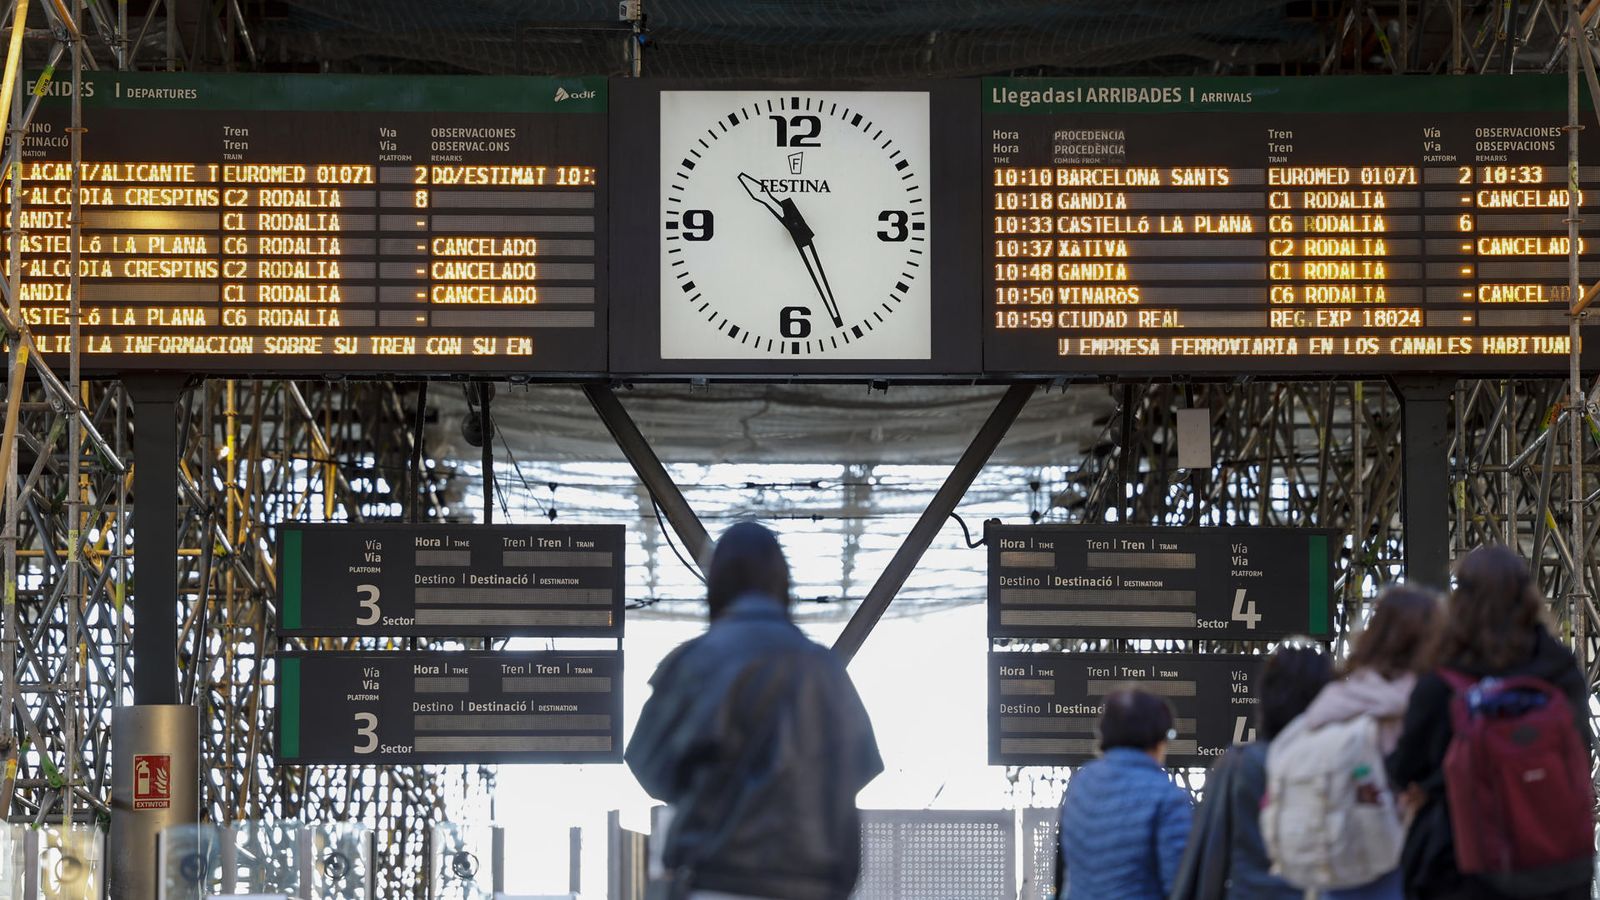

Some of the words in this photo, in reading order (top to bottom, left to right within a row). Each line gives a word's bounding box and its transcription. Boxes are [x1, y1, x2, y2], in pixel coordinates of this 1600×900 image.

[128, 89, 196, 99] DEPARTURES
[993, 88, 1074, 107] Llegadas
[1086, 88, 1181, 102] ARRIBADES
[1201, 93, 1251, 102] ARRIVALS
[224, 127, 248, 136] Tren
[432, 128, 515, 138] OBSERVACIONES
[769, 116, 821, 147] 12
[993, 130, 1018, 139] Hora
[1055, 131, 1125, 140] PROCEDENCIA
[1268, 129, 1292, 138] Tren
[1424, 128, 1440, 137] Vía
[1476, 128, 1561, 137] OBSERVACIONES
[224, 140, 248, 149] Tren
[380, 141, 396, 150] Via
[994, 144, 1018, 153] Hora
[1268, 143, 1292, 152] Tren
[1476, 141, 1555, 151] OBSERVACIONS
[224, 166, 305, 182] EUROMED
[317, 166, 373, 183] 01071
[415, 167, 427, 184] 2
[995, 169, 1051, 186] 10:10
[1057, 169, 1160, 185] BARCELONA
[1172, 169, 1229, 185] SANTS
[1269, 168, 1349, 185] EUROMED
[1361, 168, 1416, 184] 01071
[1460, 167, 1471, 183] 2
[1483, 167, 1542, 183] 10:33
[760, 180, 831, 193] FESTINA
[125, 189, 219, 206] CRESPINS
[225, 190, 248, 206] C2
[260, 190, 340, 207] RODALIA
[416, 191, 427, 207] 8
[996, 193, 1052, 209] 10:18
[1058, 193, 1126, 209] GANDIA
[1270, 192, 1291, 208] C1
[1305, 192, 1385, 208] RODALIA
[224, 213, 246, 230] C1
[259, 214, 340, 231] RODALIA
[683, 210, 713, 241] 9
[877, 211, 908, 242] 3
[995, 217, 1052, 233] 10:33
[1161, 216, 1183, 232] LA
[1195, 216, 1252, 232] PLANA
[1269, 216, 1292, 232] C6
[1305, 216, 1385, 232] RODALIA
[1460, 215, 1471, 231] 6
[114, 237, 136, 253] LA
[149, 237, 206, 253] PLANA
[225, 237, 247, 254] C6
[260, 238, 340, 254] RODALIA
[433, 239, 536, 256] CANCELADO
[996, 241, 1052, 257] 10:37
[1270, 240, 1293, 256] C2
[1305, 239, 1386, 256] RODALIA
[124, 261, 218, 278] CRESPINS
[224, 261, 247, 278] C2
[259, 262, 340, 278] RODALIA
[432, 263, 536, 279] CANCELADO
[996, 264, 1052, 280] 10:48
[1058, 264, 1127, 280] GANDIA
[1270, 263, 1291, 279] C1
[1304, 263, 1385, 279] RODALIA
[224, 285, 245, 302] C1
[259, 285, 340, 302] RODALIA
[433, 286, 536, 303] CANCELADO
[996, 288, 1053, 304] 10:50
[1271, 287, 1294, 303] C6
[1305, 287, 1385, 303] RODALIA
[112, 309, 135, 325] LA
[148, 309, 206, 325] PLANA
[223, 309, 247, 326] C6
[259, 309, 339, 326] RODALIA
[780, 307, 811, 338] 6
[996, 312, 1053, 328] 10:59
[1059, 311, 1127, 327] CIUDAD
[1139, 311, 1184, 327] REAL
[1271, 311, 1351, 327] REG.EXP
[1363, 310, 1420, 326] 18024
[88, 336, 112, 353] LA
[123, 336, 253, 353] INFORMACION
[264, 337, 323, 353] SOBRE
[334, 337, 357, 354] SU
[371, 337, 415, 354] TREN
[426, 338, 461, 354] CON
[472, 338, 496, 354] SU
[1080, 339, 1159, 355] EMPRESA
[1172, 338, 1297, 355] FERROVIARIA
[1310, 338, 1333, 354] EN
[1344, 338, 1379, 354] LOS
[1390, 338, 1472, 354] CANALES
[366, 540, 381, 550] Vía
[416, 537, 440, 546] Hora
[503, 538, 525, 547] Tren
[538, 538, 561, 547] Tren
[1000, 539, 1025, 548] Hora
[1087, 540, 1109, 549] Tren
[1121, 540, 1144, 549] Tren
[1232, 544, 1247, 554] Vía
[365, 552, 381, 562] Via
[1232, 556, 1248, 565] Via
[415, 575, 455, 584] Destino
[471, 574, 528, 584] Destinació
[1000, 576, 1040, 585] Destino
[1055, 577, 1112, 586] Destinació
[357, 585, 380, 625] 3
[1232, 589, 1261, 629] 4
[383, 615, 414, 625] Sector
[1197, 619, 1228, 628] Sector
[364, 668, 379, 677] Vía
[414, 665, 439, 674] Hora
[501, 665, 524, 673] Tren
[536, 665, 559, 673] Tren
[1000, 666, 1024, 675] Hora
[1087, 667, 1109, 676] Tren
[1122, 668, 1145, 676] Tren
[1232, 671, 1247, 680] Vía
[363, 680, 379, 689] Via
[1232, 683, 1248, 692] Via
[413, 702, 453, 711] Destino
[469, 701, 526, 711] Destinació
[1000, 704, 1040, 713] Destino
[354, 713, 378, 753] 3
[381, 745, 412, 753] Sector
